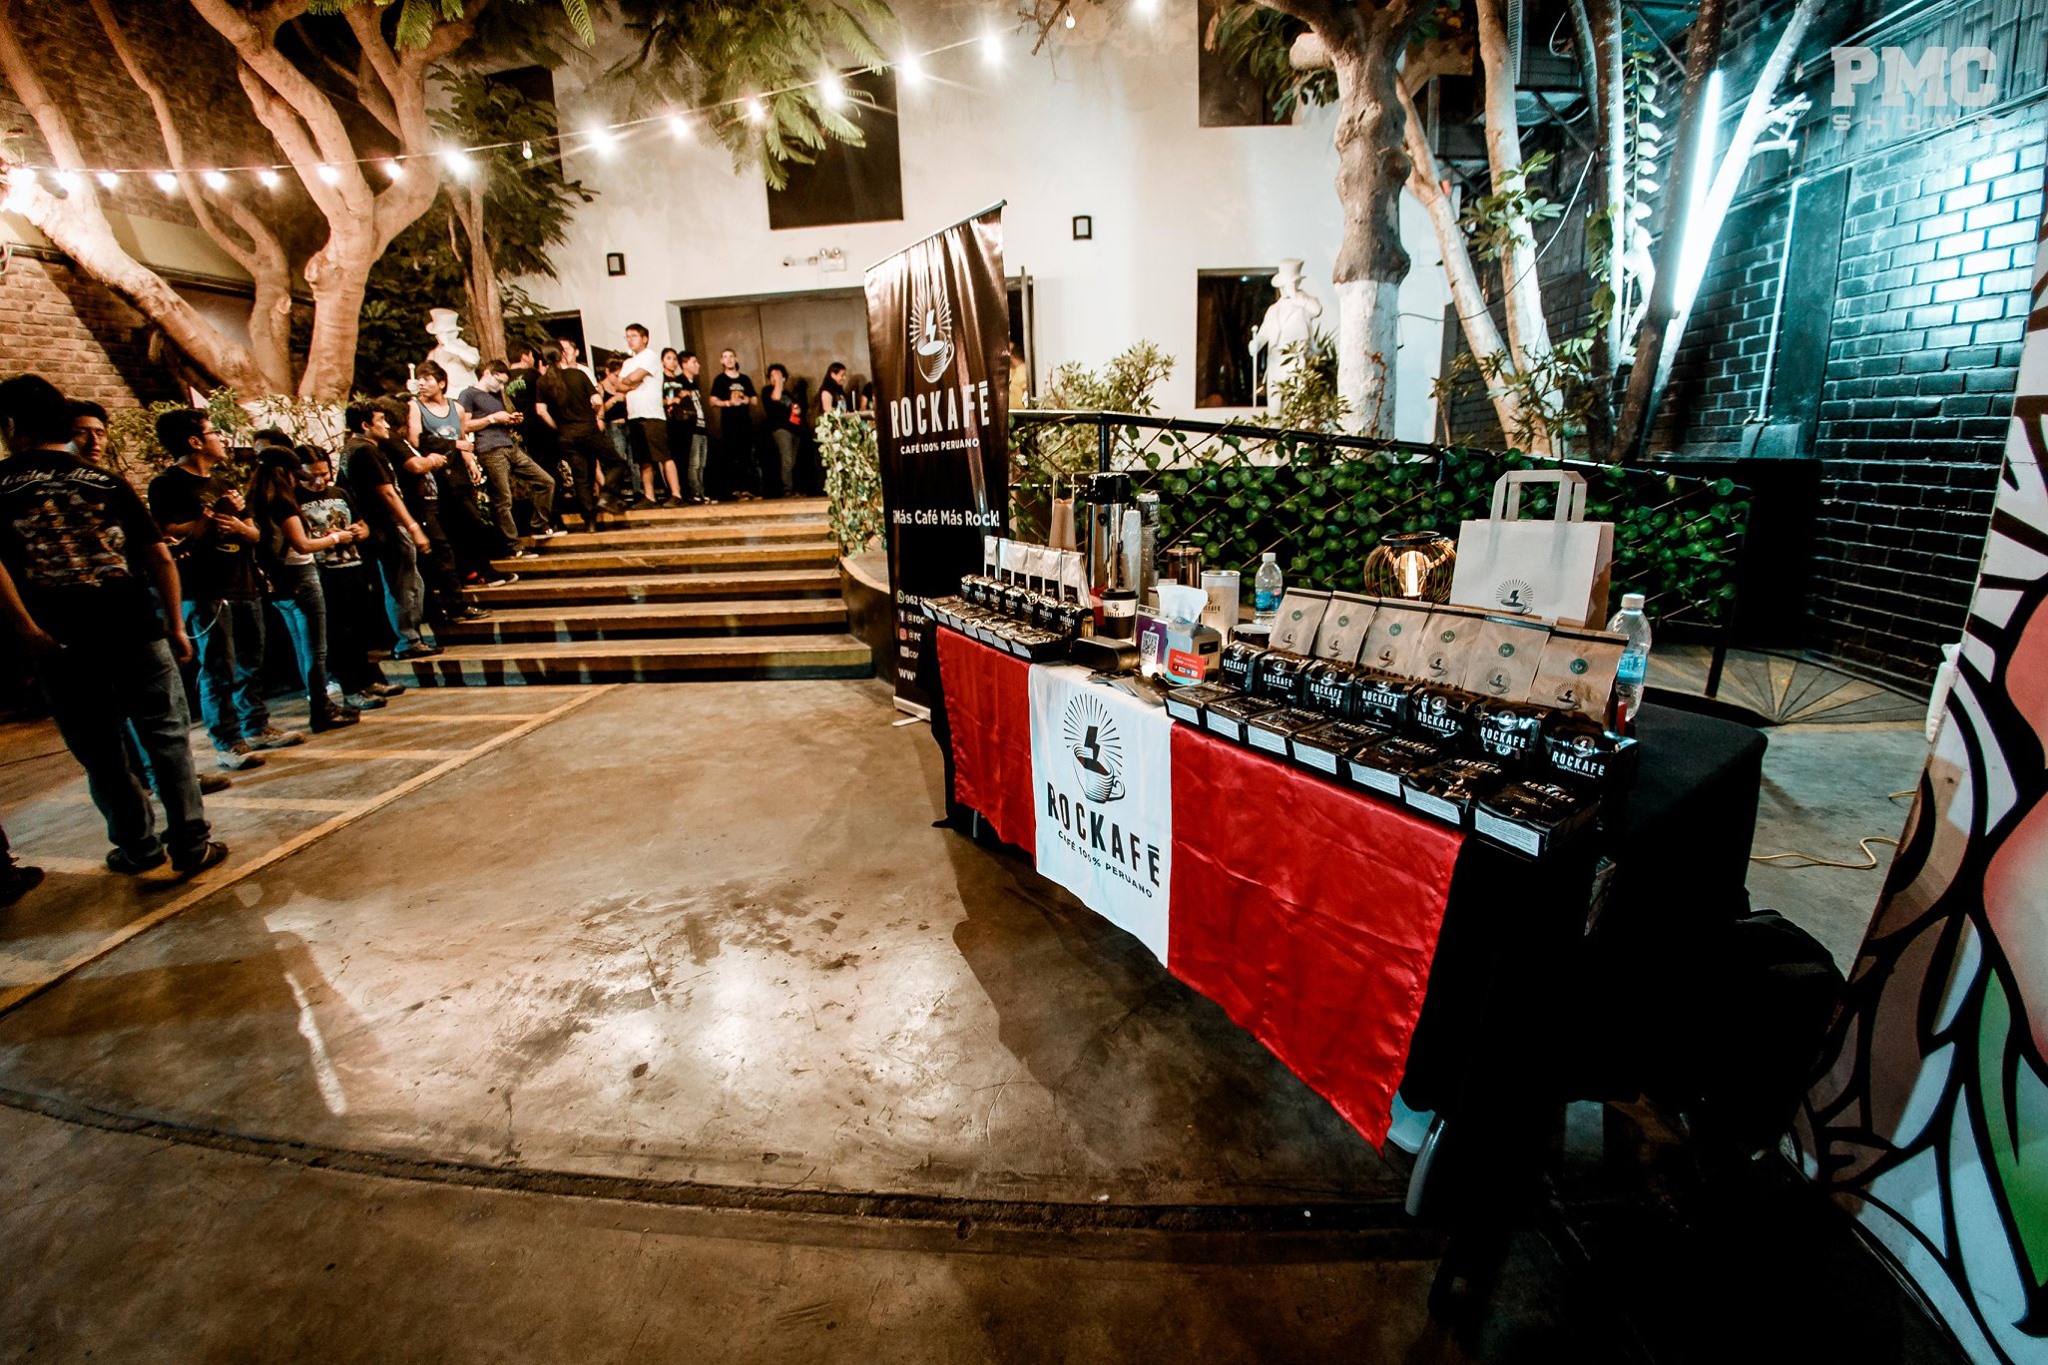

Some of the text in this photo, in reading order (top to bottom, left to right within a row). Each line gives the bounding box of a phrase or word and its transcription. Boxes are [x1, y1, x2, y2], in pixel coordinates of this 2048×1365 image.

[900, 438, 980, 455] CAFÉ 100% PERUANO
[915, 509, 938, 525] Café
[941, 509, 963, 526] Más
[965, 509, 1000, 527] Rock!
[1058, 830, 1152, 898] CAFÉ 100% PERUANO
